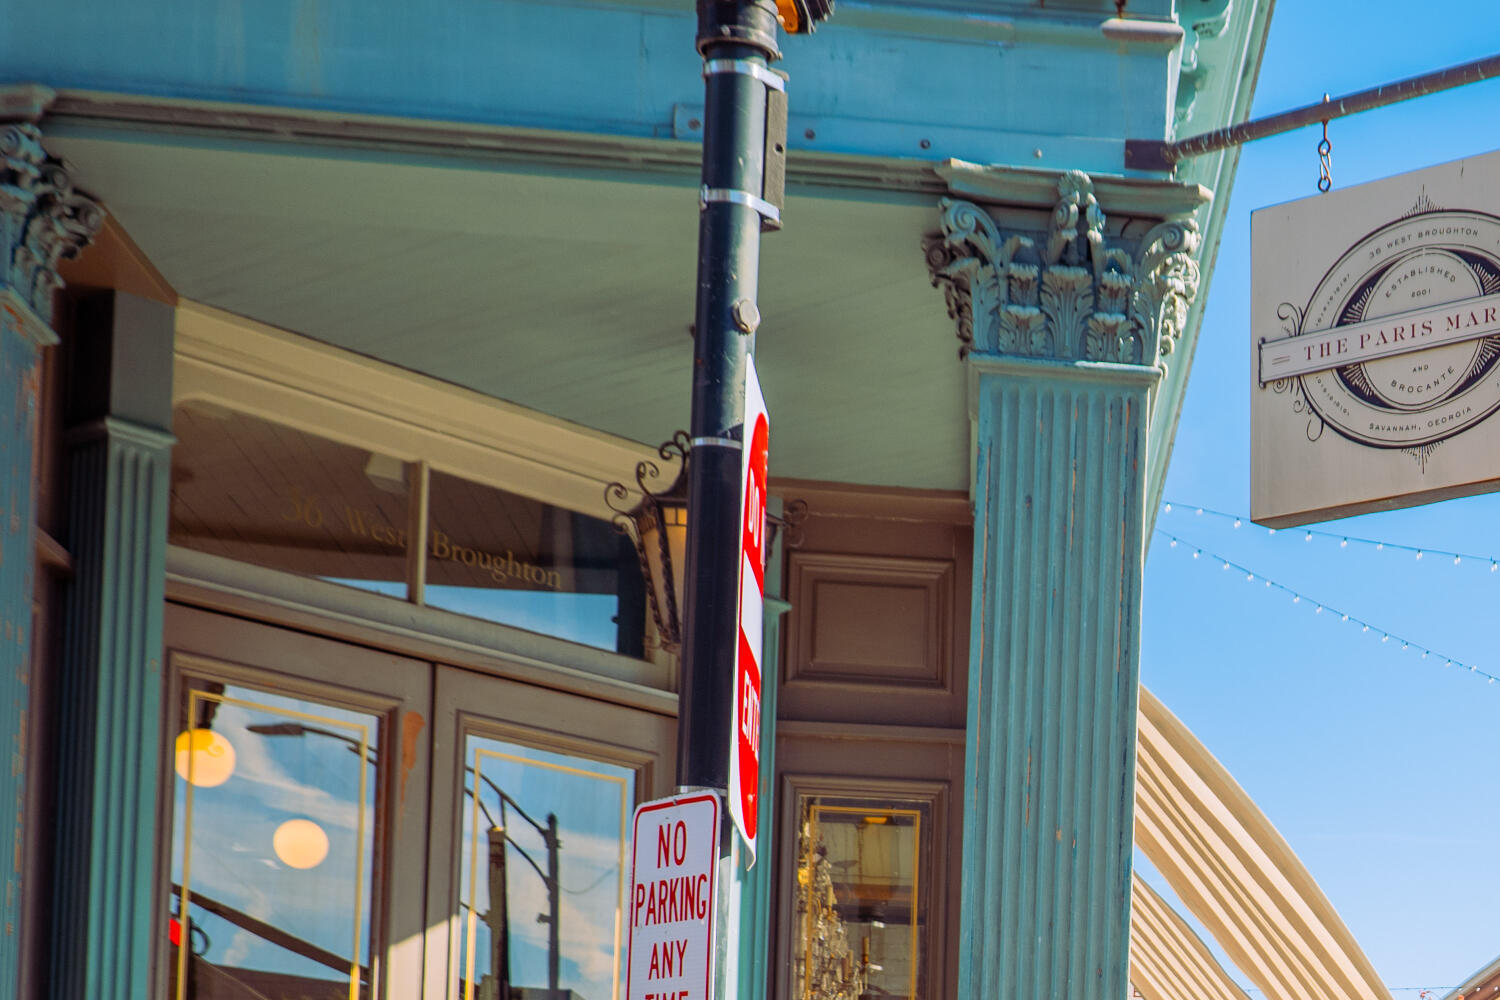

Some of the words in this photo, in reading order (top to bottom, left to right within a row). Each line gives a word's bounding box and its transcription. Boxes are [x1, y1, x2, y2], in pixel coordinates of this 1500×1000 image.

[1387, 234, 1413, 249] WEST
[1418, 227, 1479, 239] BROUGHTON
[1385, 265, 1457, 299] ESTABLISHED
[1304, 338, 1348, 361] THE
[1359, 320, 1434, 350] PARIS
[1390, 365, 1456, 394] BROCANTE
[1412, 364, 1430, 374] AND
[1369, 422, 1421, 433] SAVANNAH,
[1427, 406, 1472, 429] GEORGIA
[281, 487, 322, 528] 36
[432, 529, 562, 590] Broughton
[657, 820, 687, 869] NO
[635, 873, 707, 928] PARKING
[648, 939, 688, 981] ANY
